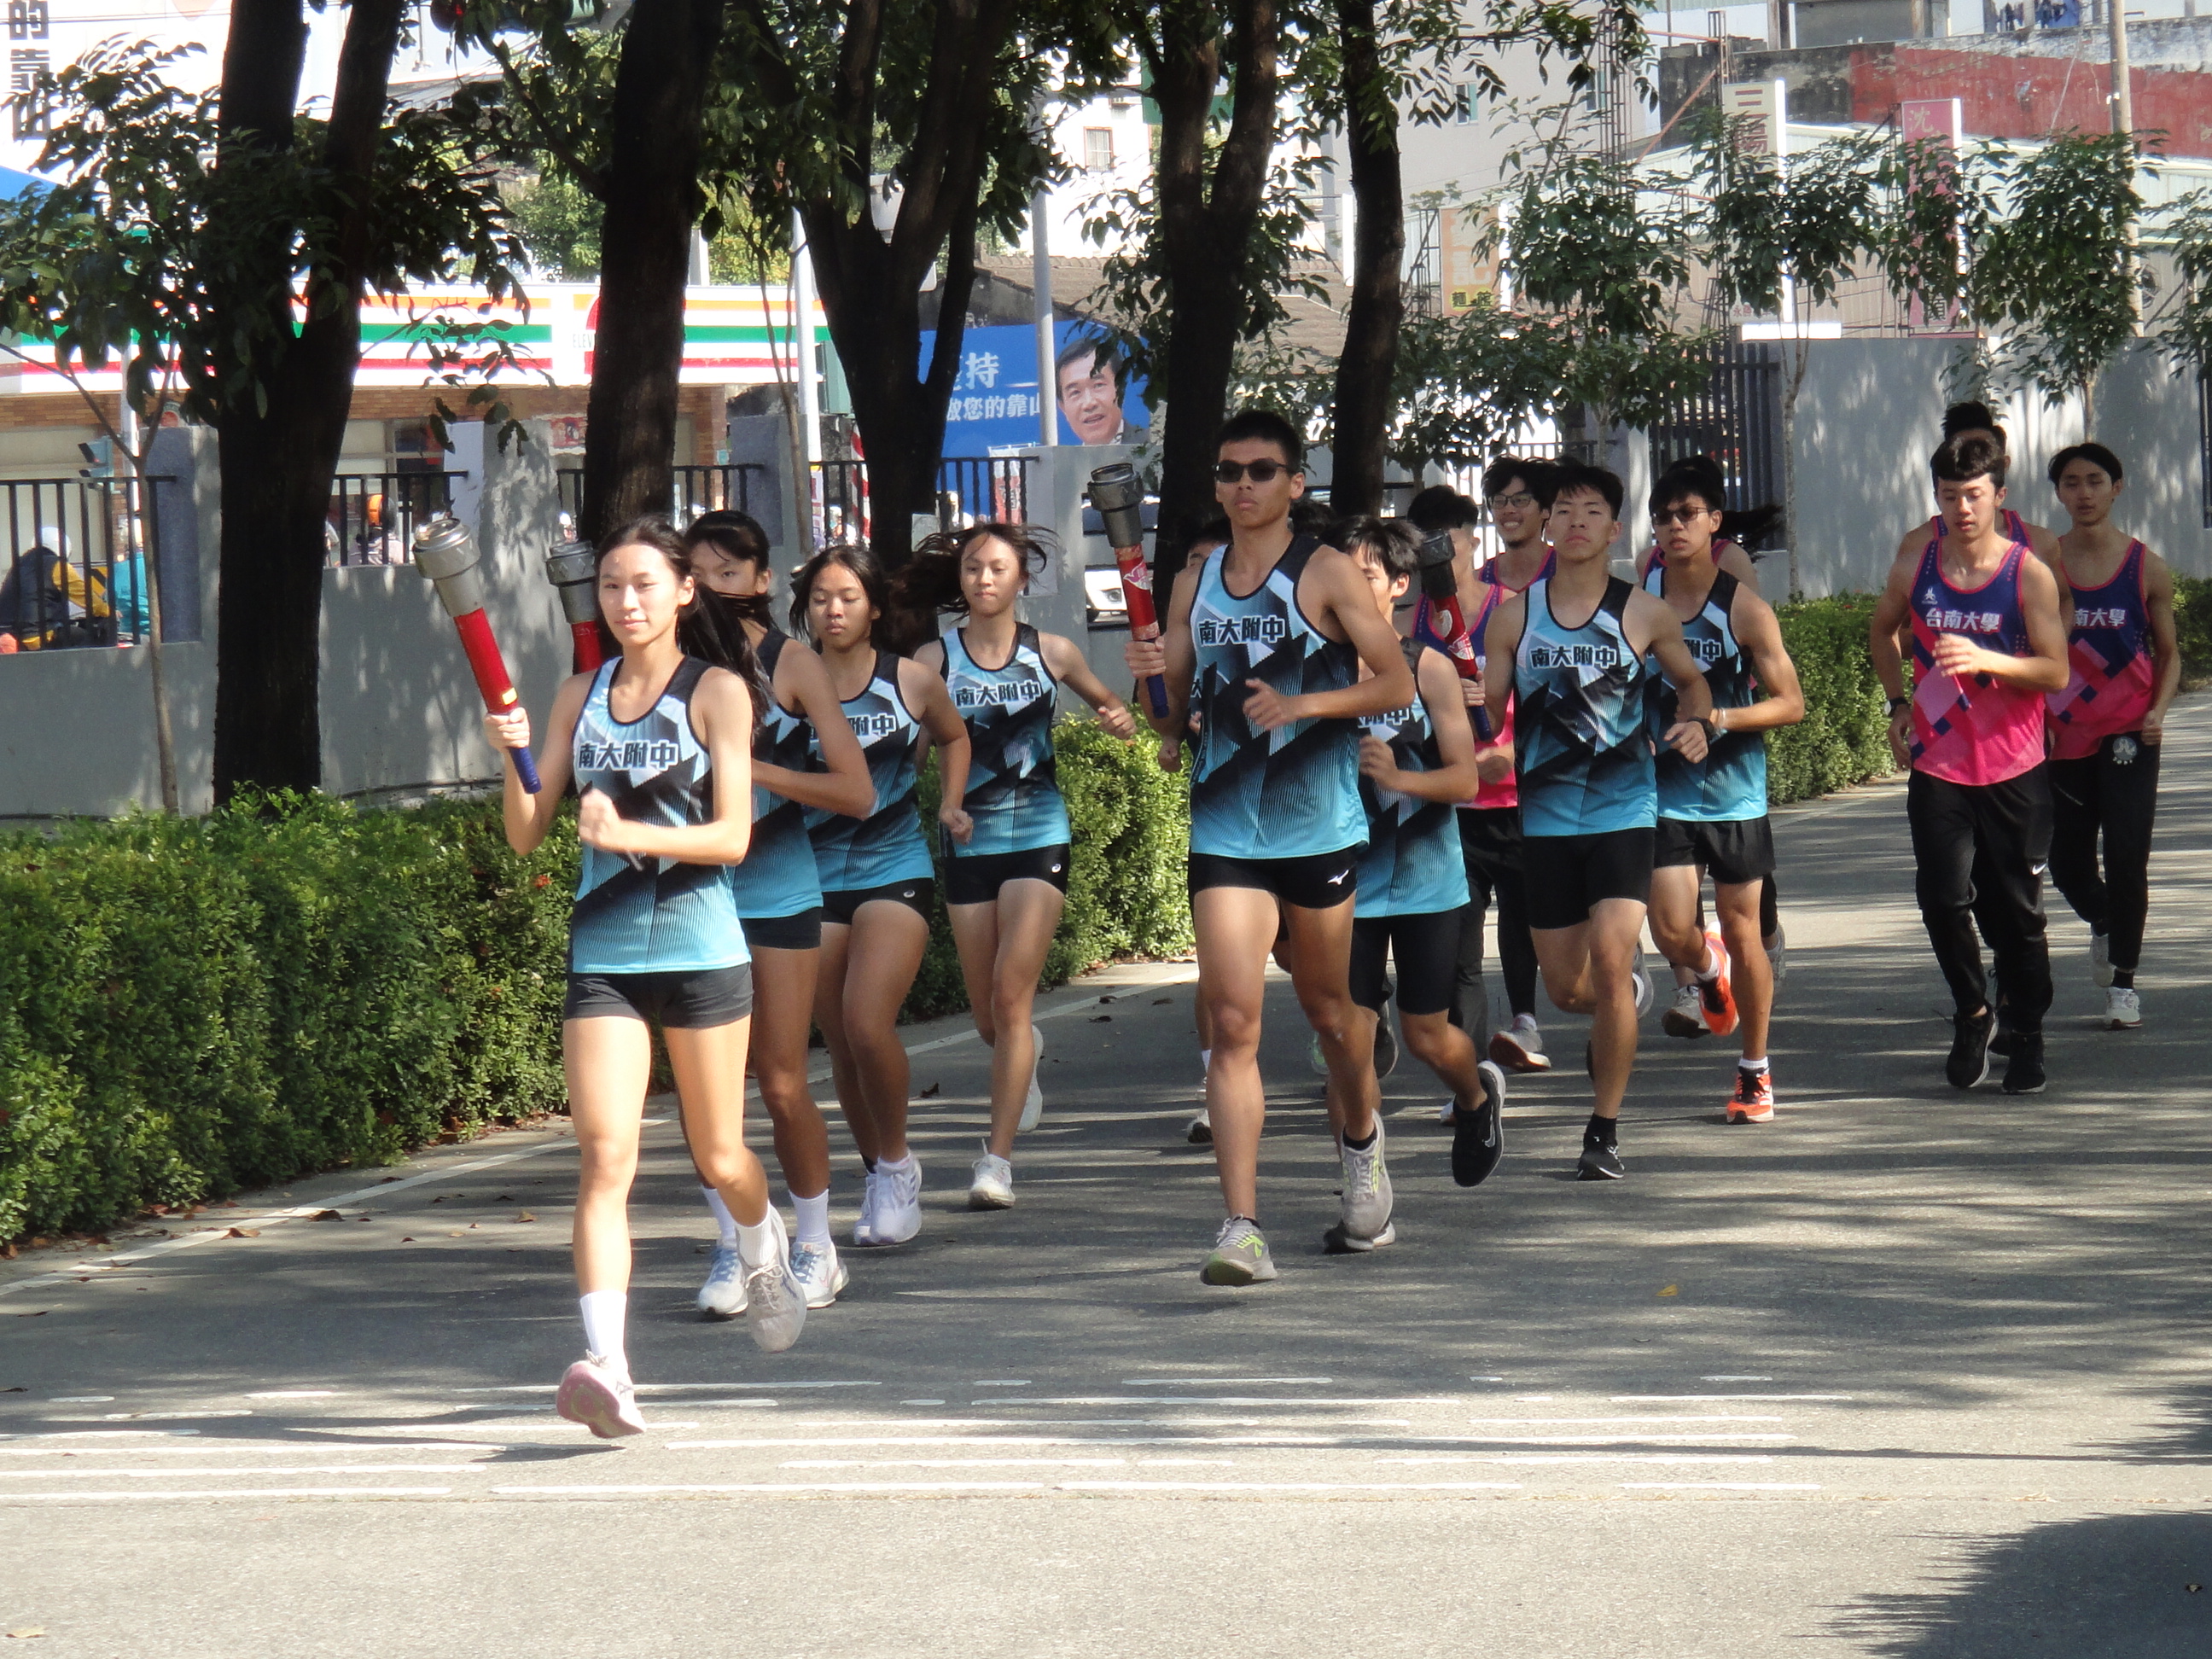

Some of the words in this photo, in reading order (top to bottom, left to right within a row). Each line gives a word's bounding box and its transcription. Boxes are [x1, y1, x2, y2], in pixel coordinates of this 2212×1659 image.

[573, 334, 595, 348] ELEV
[1926, 607, 2001, 633] 台南大學
[2075, 607, 2126, 627] 南大學
[1198, 614, 1285, 647] 南大附中
[1530, 644, 1616, 669] 南大附中
[956, 679, 1041, 708] 南大附中
[579, 739, 679, 771] 南大附中
